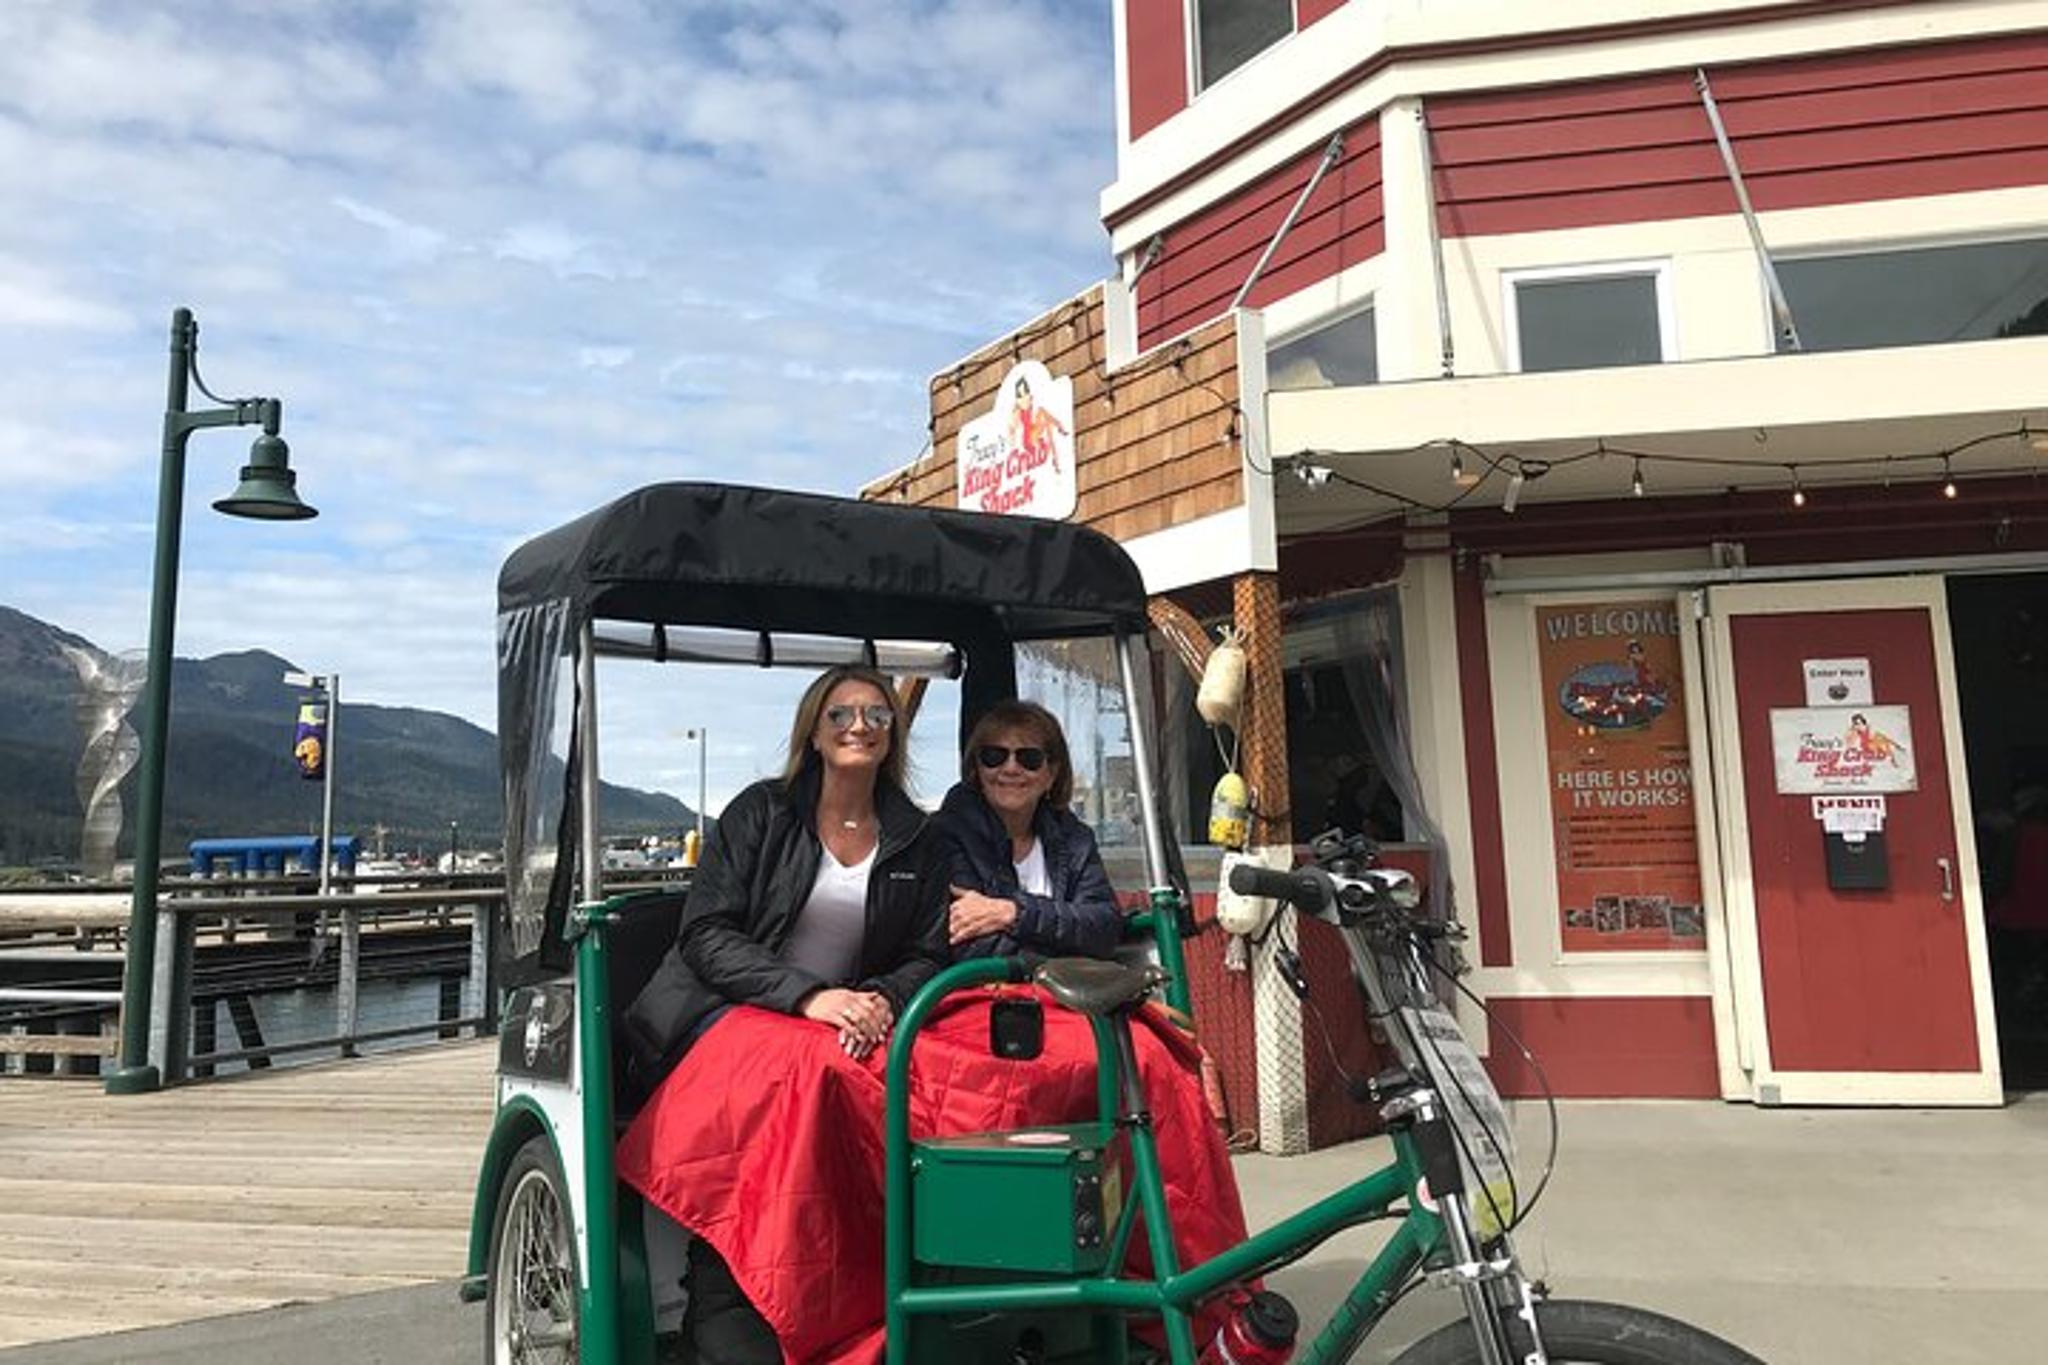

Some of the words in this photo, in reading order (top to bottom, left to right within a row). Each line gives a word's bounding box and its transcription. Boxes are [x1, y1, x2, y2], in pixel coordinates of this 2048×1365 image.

[962, 461, 1004, 497] King
[1006, 437, 1047, 478] Crab
[981, 475, 1035, 513] Shack
[1547, 610, 1681, 641] WELCOME
[1840, 668, 1865, 678] Here
[1797, 749, 1842, 766] King
[1843, 747, 1887, 762] Crab
[1557, 770, 1614, 789] HERE
[1620, 769, 1640, 787] IS
[1813, 762, 1873, 778] Shack
[1574, 790, 1593, 808] IT
[1598, 788, 1687, 807] WORKS:
